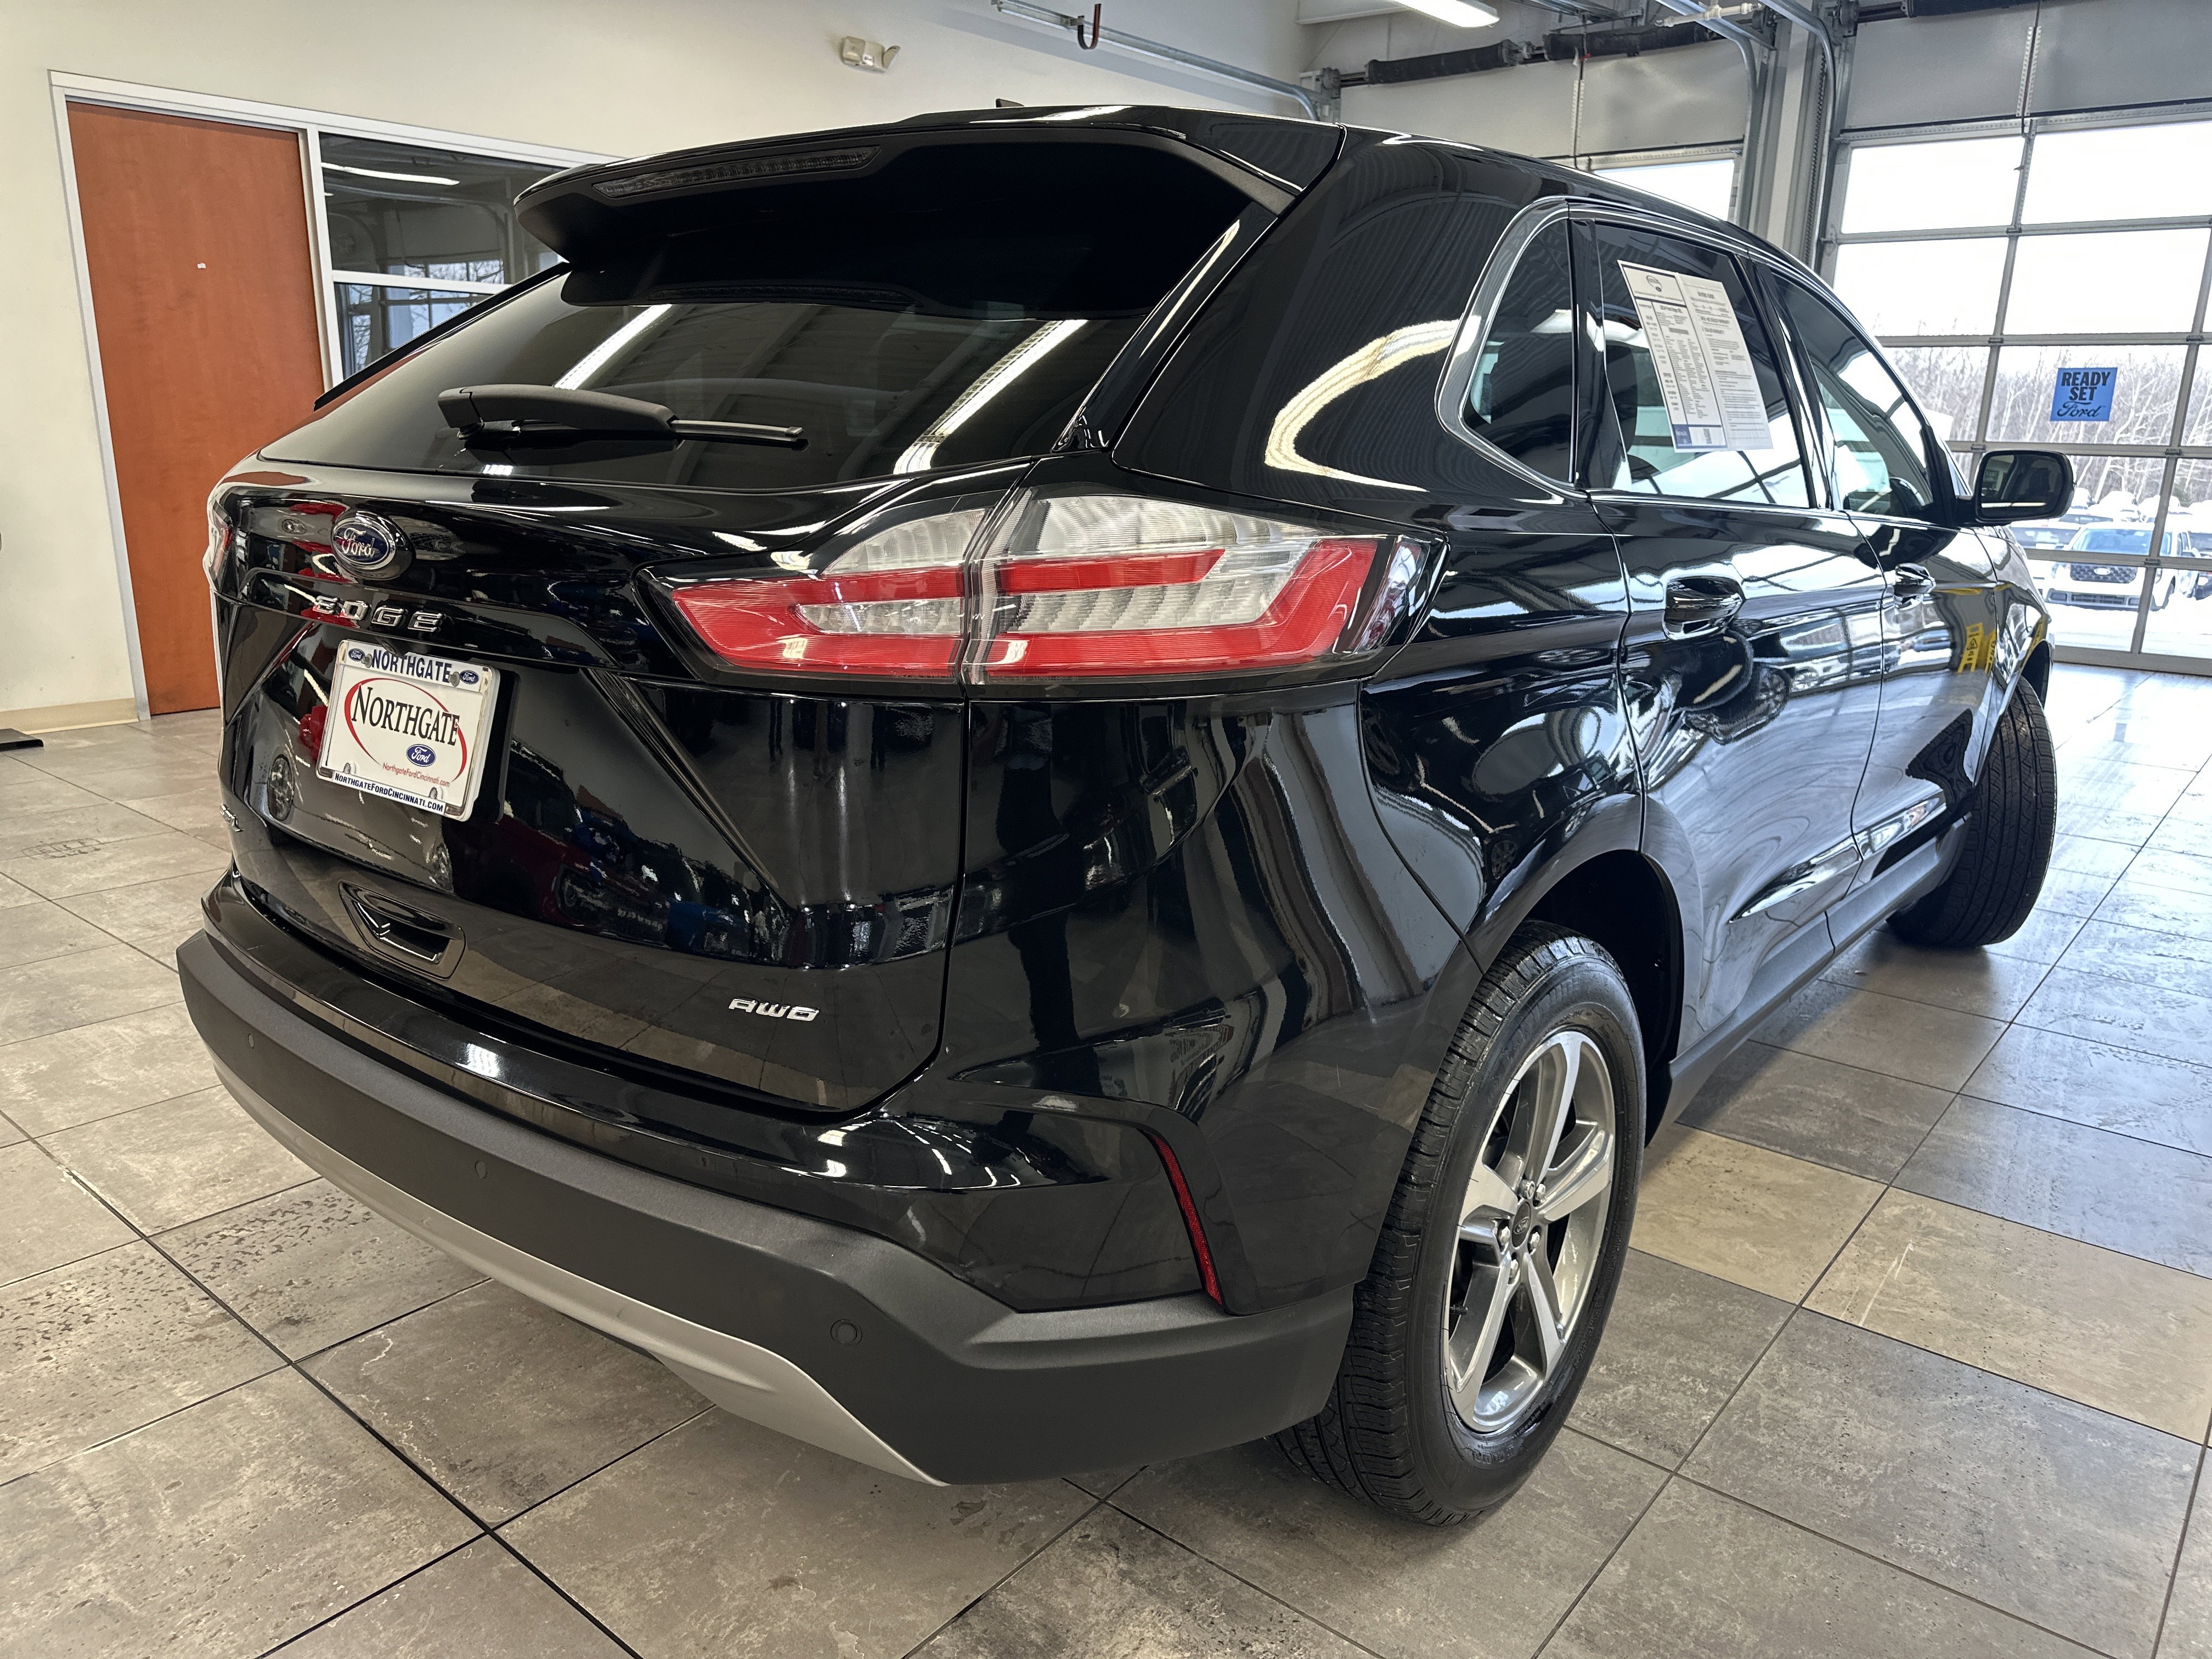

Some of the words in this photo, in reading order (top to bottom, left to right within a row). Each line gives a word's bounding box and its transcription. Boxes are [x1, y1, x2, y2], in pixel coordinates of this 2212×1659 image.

[2061, 371, 2111, 386] READY
[2069, 387, 2097, 400] SET
[2057, 401, 2102, 417] Ford
[341, 527, 375, 558] Ford
[312, 595, 443, 633] EDGE
[371, 649, 452, 683] NORTHGATE
[462, 671, 476, 682] Ford
[352, 684, 460, 746] NORTHGATE
[411, 747, 431, 763] Ford
[382, 763, 450, 787] NorthgateFordCincinnati.com
[729, 997, 821, 1022] AWD
